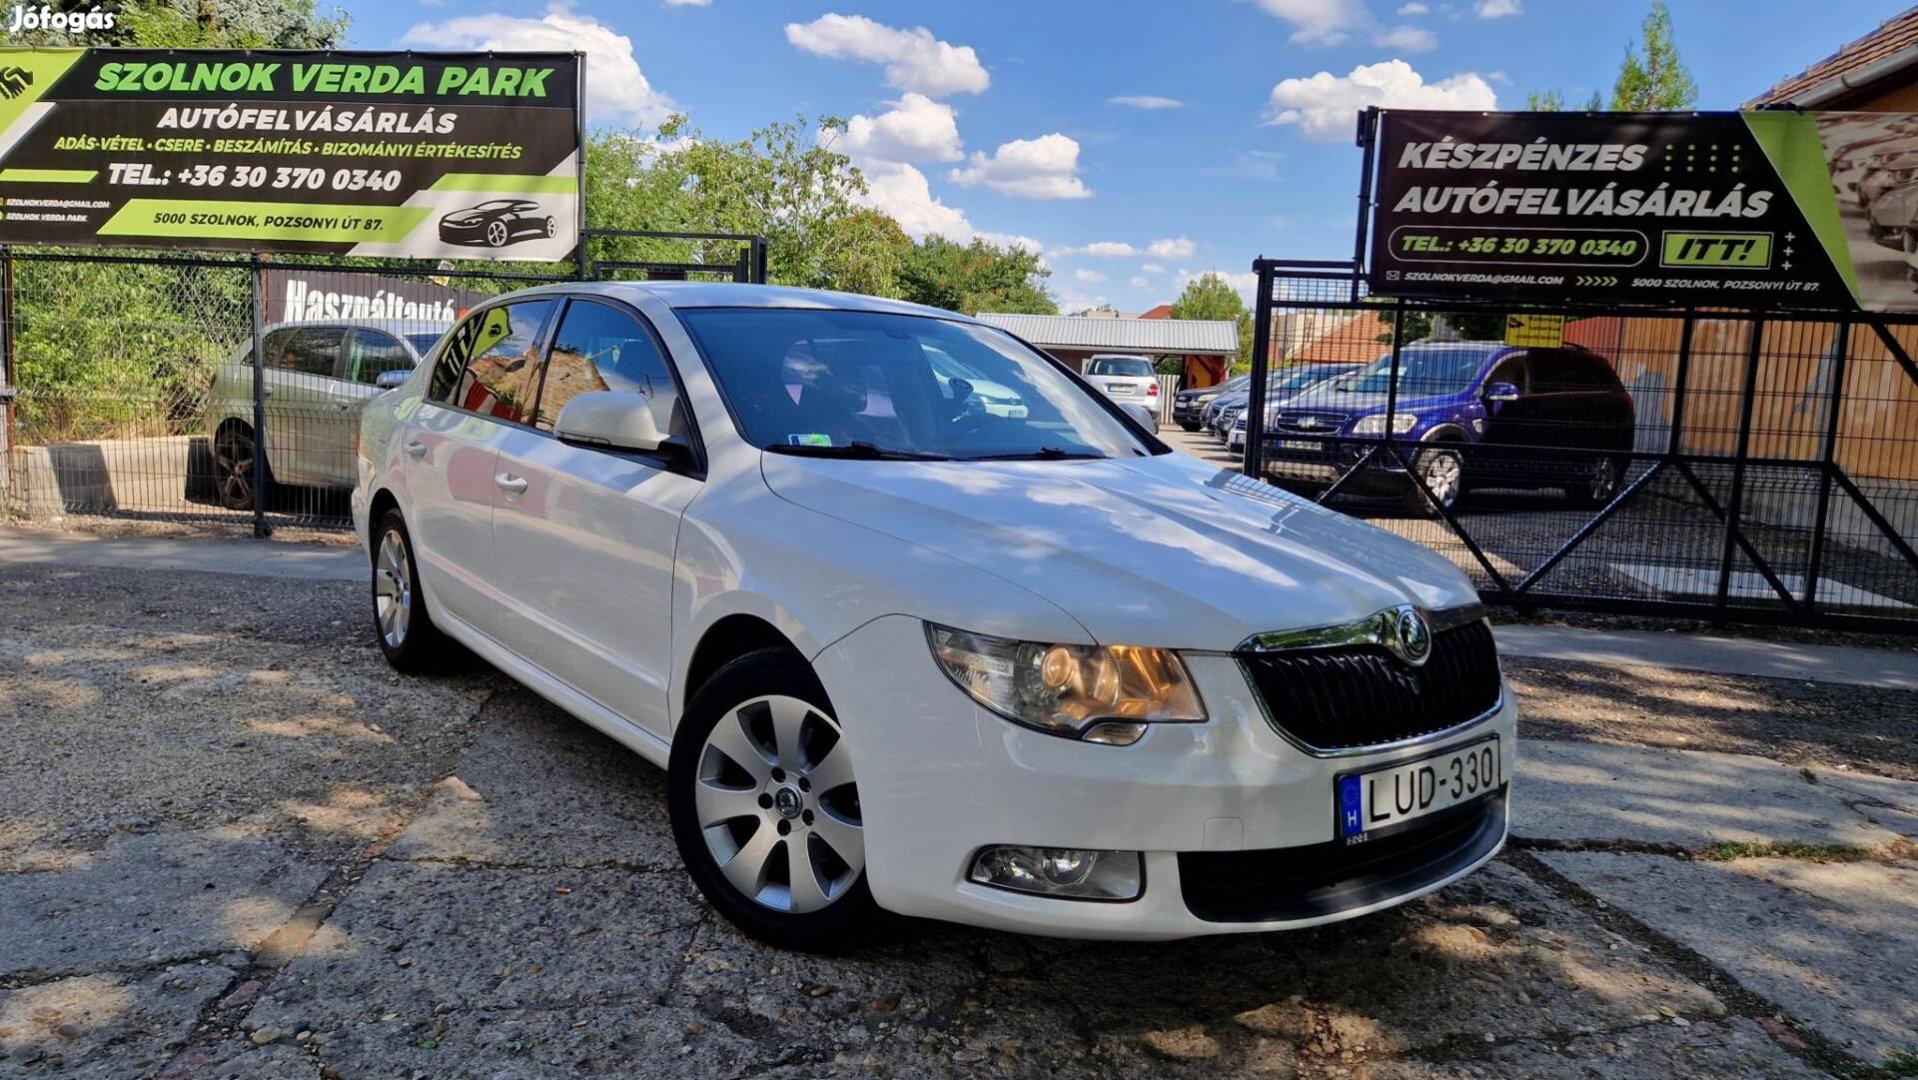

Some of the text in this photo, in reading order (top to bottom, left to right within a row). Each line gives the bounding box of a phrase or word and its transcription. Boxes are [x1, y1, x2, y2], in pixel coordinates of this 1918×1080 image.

[94, 62, 555, 97] SZOLNOK VERDA PARK
[156, 103, 458, 135] AUTÓFELVÁSÁRLÁS
[54, 134, 523, 159] ADÁS-VÉTEL CSERE BESZÁMÍTÁS BIZOMÁNYI ÉRTÉKESÍTÉS
[1398, 135, 1650, 172] KÉSZPÉNZES
[108, 163, 402, 192] TEL.: +36 30 370 0340
[1392, 179, 1774, 218] AUTÓFELVÁSÁRLÁS
[6, 212, 88, 222] SZOLNOK VERDA PARK
[153, 213, 384, 231] 5000 SZOLNOK, POZSONYI ÚT 87.
[1401, 235, 1637, 256] TEL.: +36 30 370 0340
[1676, 238, 1757, 261] ITT!
[1403, 271, 1564, 286] SZOLNOKVERDA@GMAIL.COM
[1632, 278, 1663, 288] 5000
[1723, 280, 1784, 291] POZSONYI
[1785, 279, 1803, 291] ÚT
[1803, 282, 1820, 292] 87.
[1369, 746, 1493, 822] LUD-330
[1346, 809, 1358, 828] H
